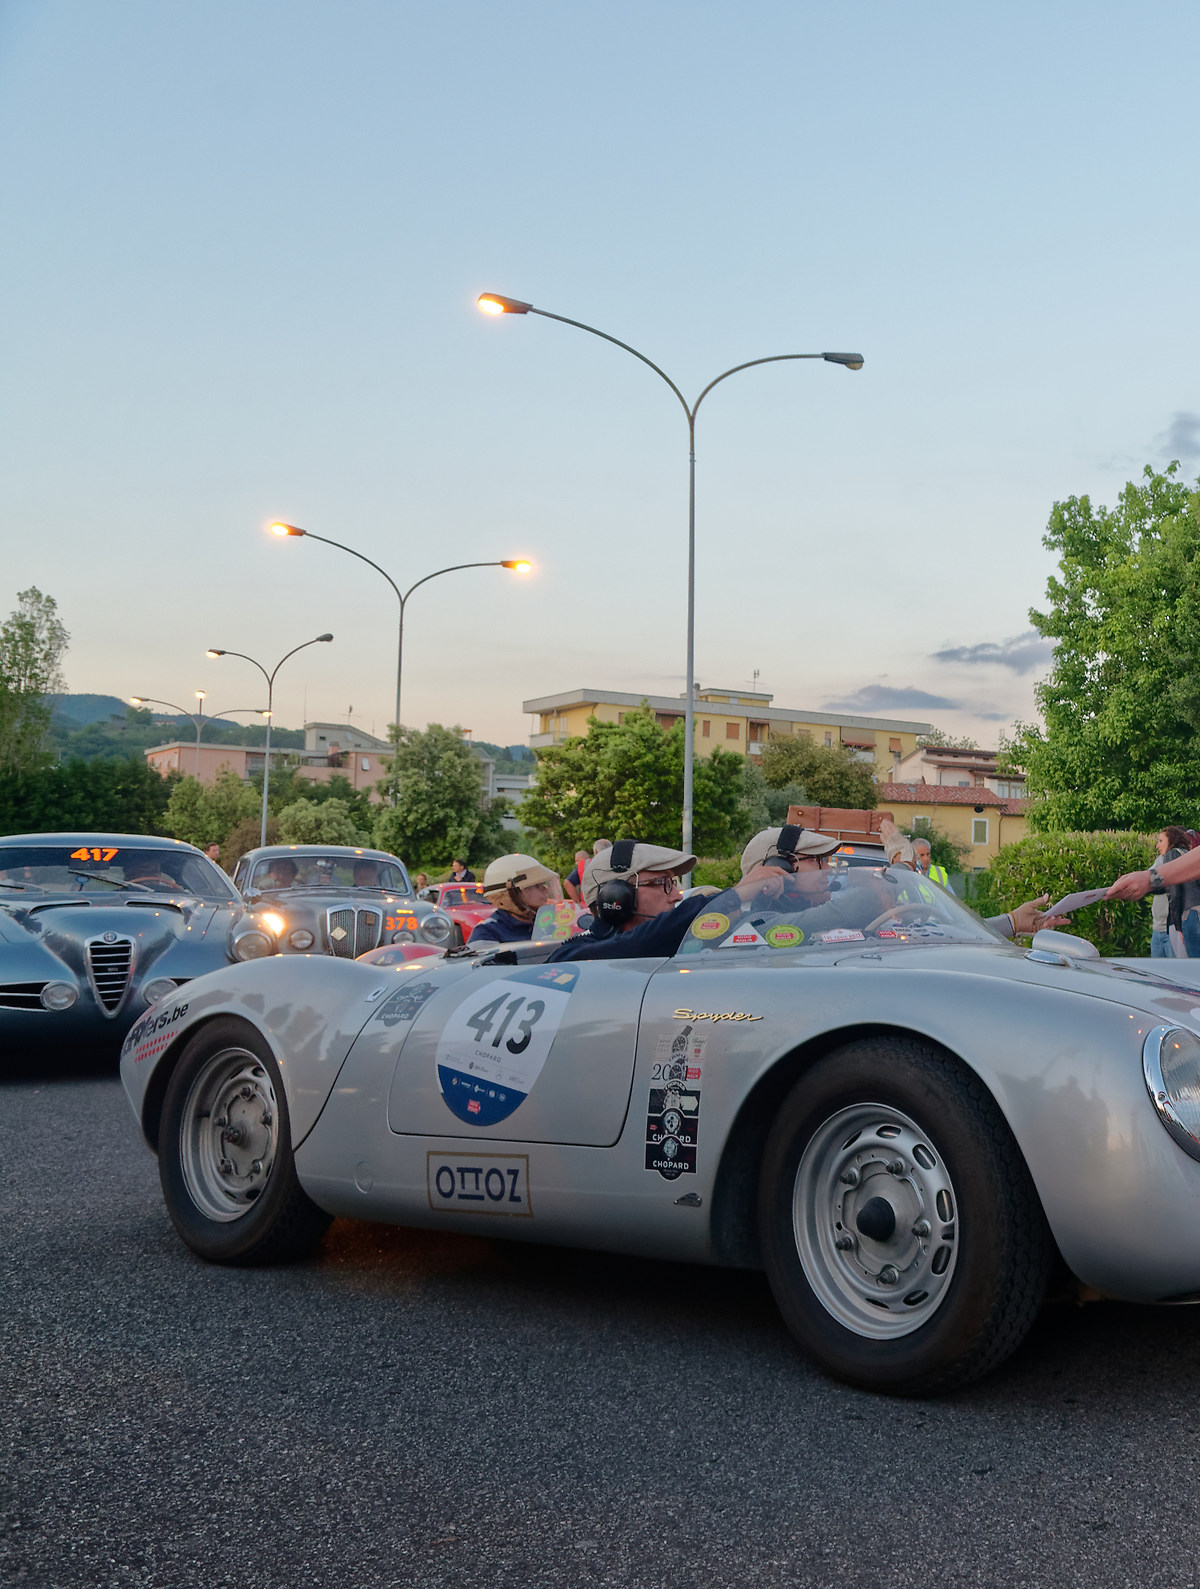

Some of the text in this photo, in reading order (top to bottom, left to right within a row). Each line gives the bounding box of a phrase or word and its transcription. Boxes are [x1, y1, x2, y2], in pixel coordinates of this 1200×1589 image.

[70, 847, 119, 862] 417
[385, 916, 418, 931] 378
[672, 1008, 764, 1023] Spyder
[466, 992, 546, 1055] 413
[474, 1049, 502, 1063] CHOPARD
[652, 1160, 690, 1170] CHOPARD
[435, 1165, 522, 1203] OTTOZ
